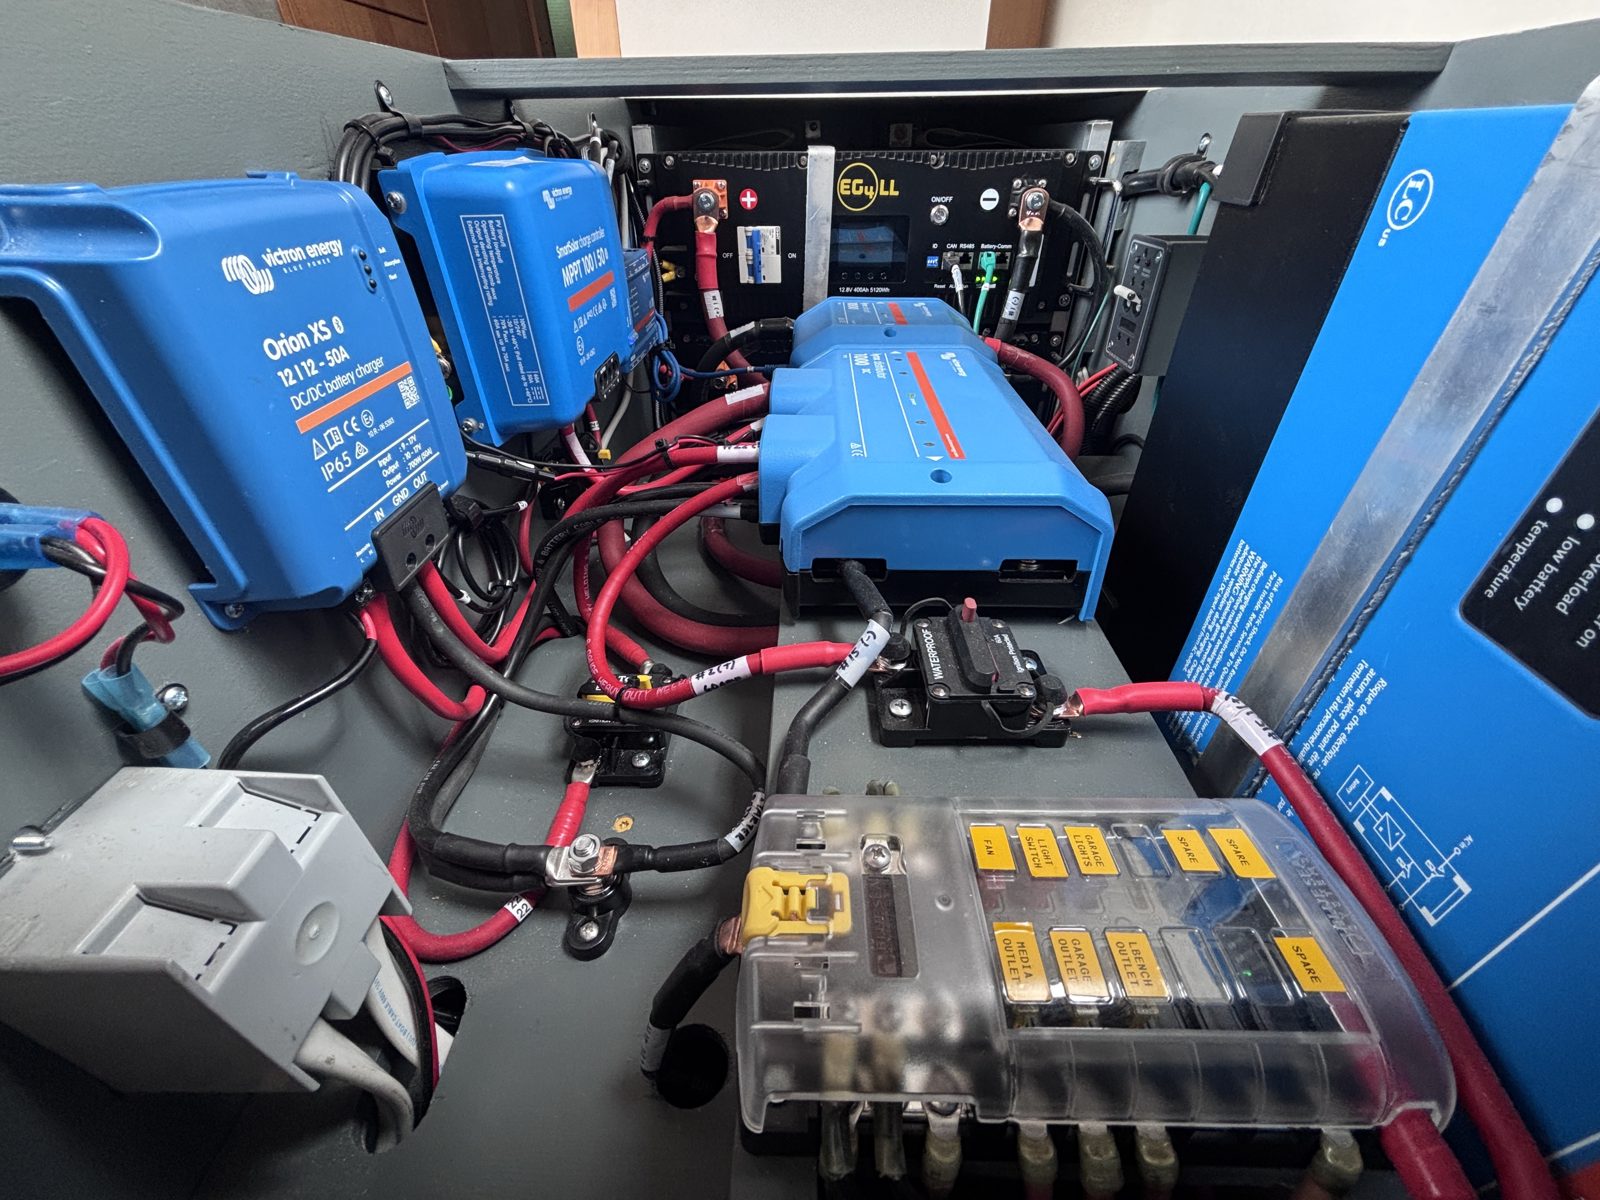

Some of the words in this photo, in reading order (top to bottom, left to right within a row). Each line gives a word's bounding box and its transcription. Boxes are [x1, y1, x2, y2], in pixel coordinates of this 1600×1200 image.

[262, 247, 305, 267] victron
[306, 240, 343, 260] energy
[556, 239, 579, 258] SmartSolar
[283, 264, 303, 274] BLUE
[307, 258, 330, 267] POWER
[562, 260, 582, 287] MPPT
[582, 254, 594, 274] 100
[596, 248, 605, 266] 50
[264, 332, 310, 360] Orion
[308, 320, 331, 344] XS
[277, 368, 297, 387] 12
[300, 358, 318, 376] 12
[325, 346, 350, 366] 50A
[290, 384, 326, 410] DC/DC
[324, 372, 355, 393] battery
[356, 357, 384, 378] charger
[321, 451, 352, 480] IP65
[376, 453, 392, 467] Input
[382, 461, 400, 477] Output
[386, 472, 404, 488] Power
[411, 471, 427, 488] OUT
[390, 488, 410, 506] GND
[374, 508, 385, 522] IN
[541, 529, 569, 556] BATTERY
[1552, 536, 1581, 564] low
[1253, 556, 1262, 568] the
[1484, 519, 1549, 598] temperature
[1241, 566, 1255, 590] supply
[1254, 561, 1267, 584] Before
[1265, 571, 1277, 589] Parts
[1272, 576, 1283, 592] Risk
[1218, 583, 1225, 594] DC
[1218, 578, 1234, 610] ventilation
[1240, 584, 1256, 612] charging
[1268, 592, 1274, 602] of
[1514, 563, 1559, 611] battery
[1211, 592, 1221, 609] input
[1219, 595, 1234, 624] Explosive
[1233, 589, 1245, 610] before
[1254, 590, 1267, 611] Inside.
[1208, 612, 1219, 632] during
[1222, 610, 1235, 633] making
[1234, 611, 1242, 626] read
[1245, 612, 1256, 630] Refer
[1255, 601, 1270, 625] Electric
[1229, 625, 1237, 636] the
[1576, 628, 1596, 648] on
[918, 628, 948, 679] WATERPROOF
[1200, 641, 1212, 664] prevent
[1206, 638, 1222, 664] breaking
[1230, 630, 1246, 659] Servicing
[1240, 647, 1246, 656] Do
[1226, 659, 1232, 667] To
[1233, 656, 1241, 668] Not
[598, 677, 620, 697] HEAVY
[624, 689, 651, 701] DUTY
[1340, 660, 1368, 697] l'entretien
[1354, 668, 1376, 697] aucune
[1365, 678, 1387, 704] Risque
[1329, 701, 1338, 713] du
[1337, 697, 1354, 720] pièce
[1357, 704, 1366, 716] de
[1308, 710, 1334, 746] personnel
[1318, 719, 1340, 751] pouvant
[1345, 715, 1359, 733] choc
[1307, 751, 1320, 766] être
[1322, 733, 1347, 766] électrique
[983, 839, 994, 856] FAN
[1024, 835, 1042, 869] SWITCH
[1036, 838, 1054, 866] LIGHT
[1073, 834, 1092, 867] LIGHTS
[1084, 834, 1105, 868] GARAGE
[1177, 836, 1199, 864] SPARE
[1226, 838, 1251, 867] SPARE
[516, 903, 531, 919] 22
[1002, 938, 1022, 983] OUTLET
[1016, 941, 1032, 979] MEDIA
[1058, 938, 1077, 983] OUTLET
[1070, 938, 1092, 982] GARAGE
[1116, 941, 1139, 986] OUTLET
[1292, 945, 1321, 983] SPARE
[382, 1002, 400, 1021] CABLE
